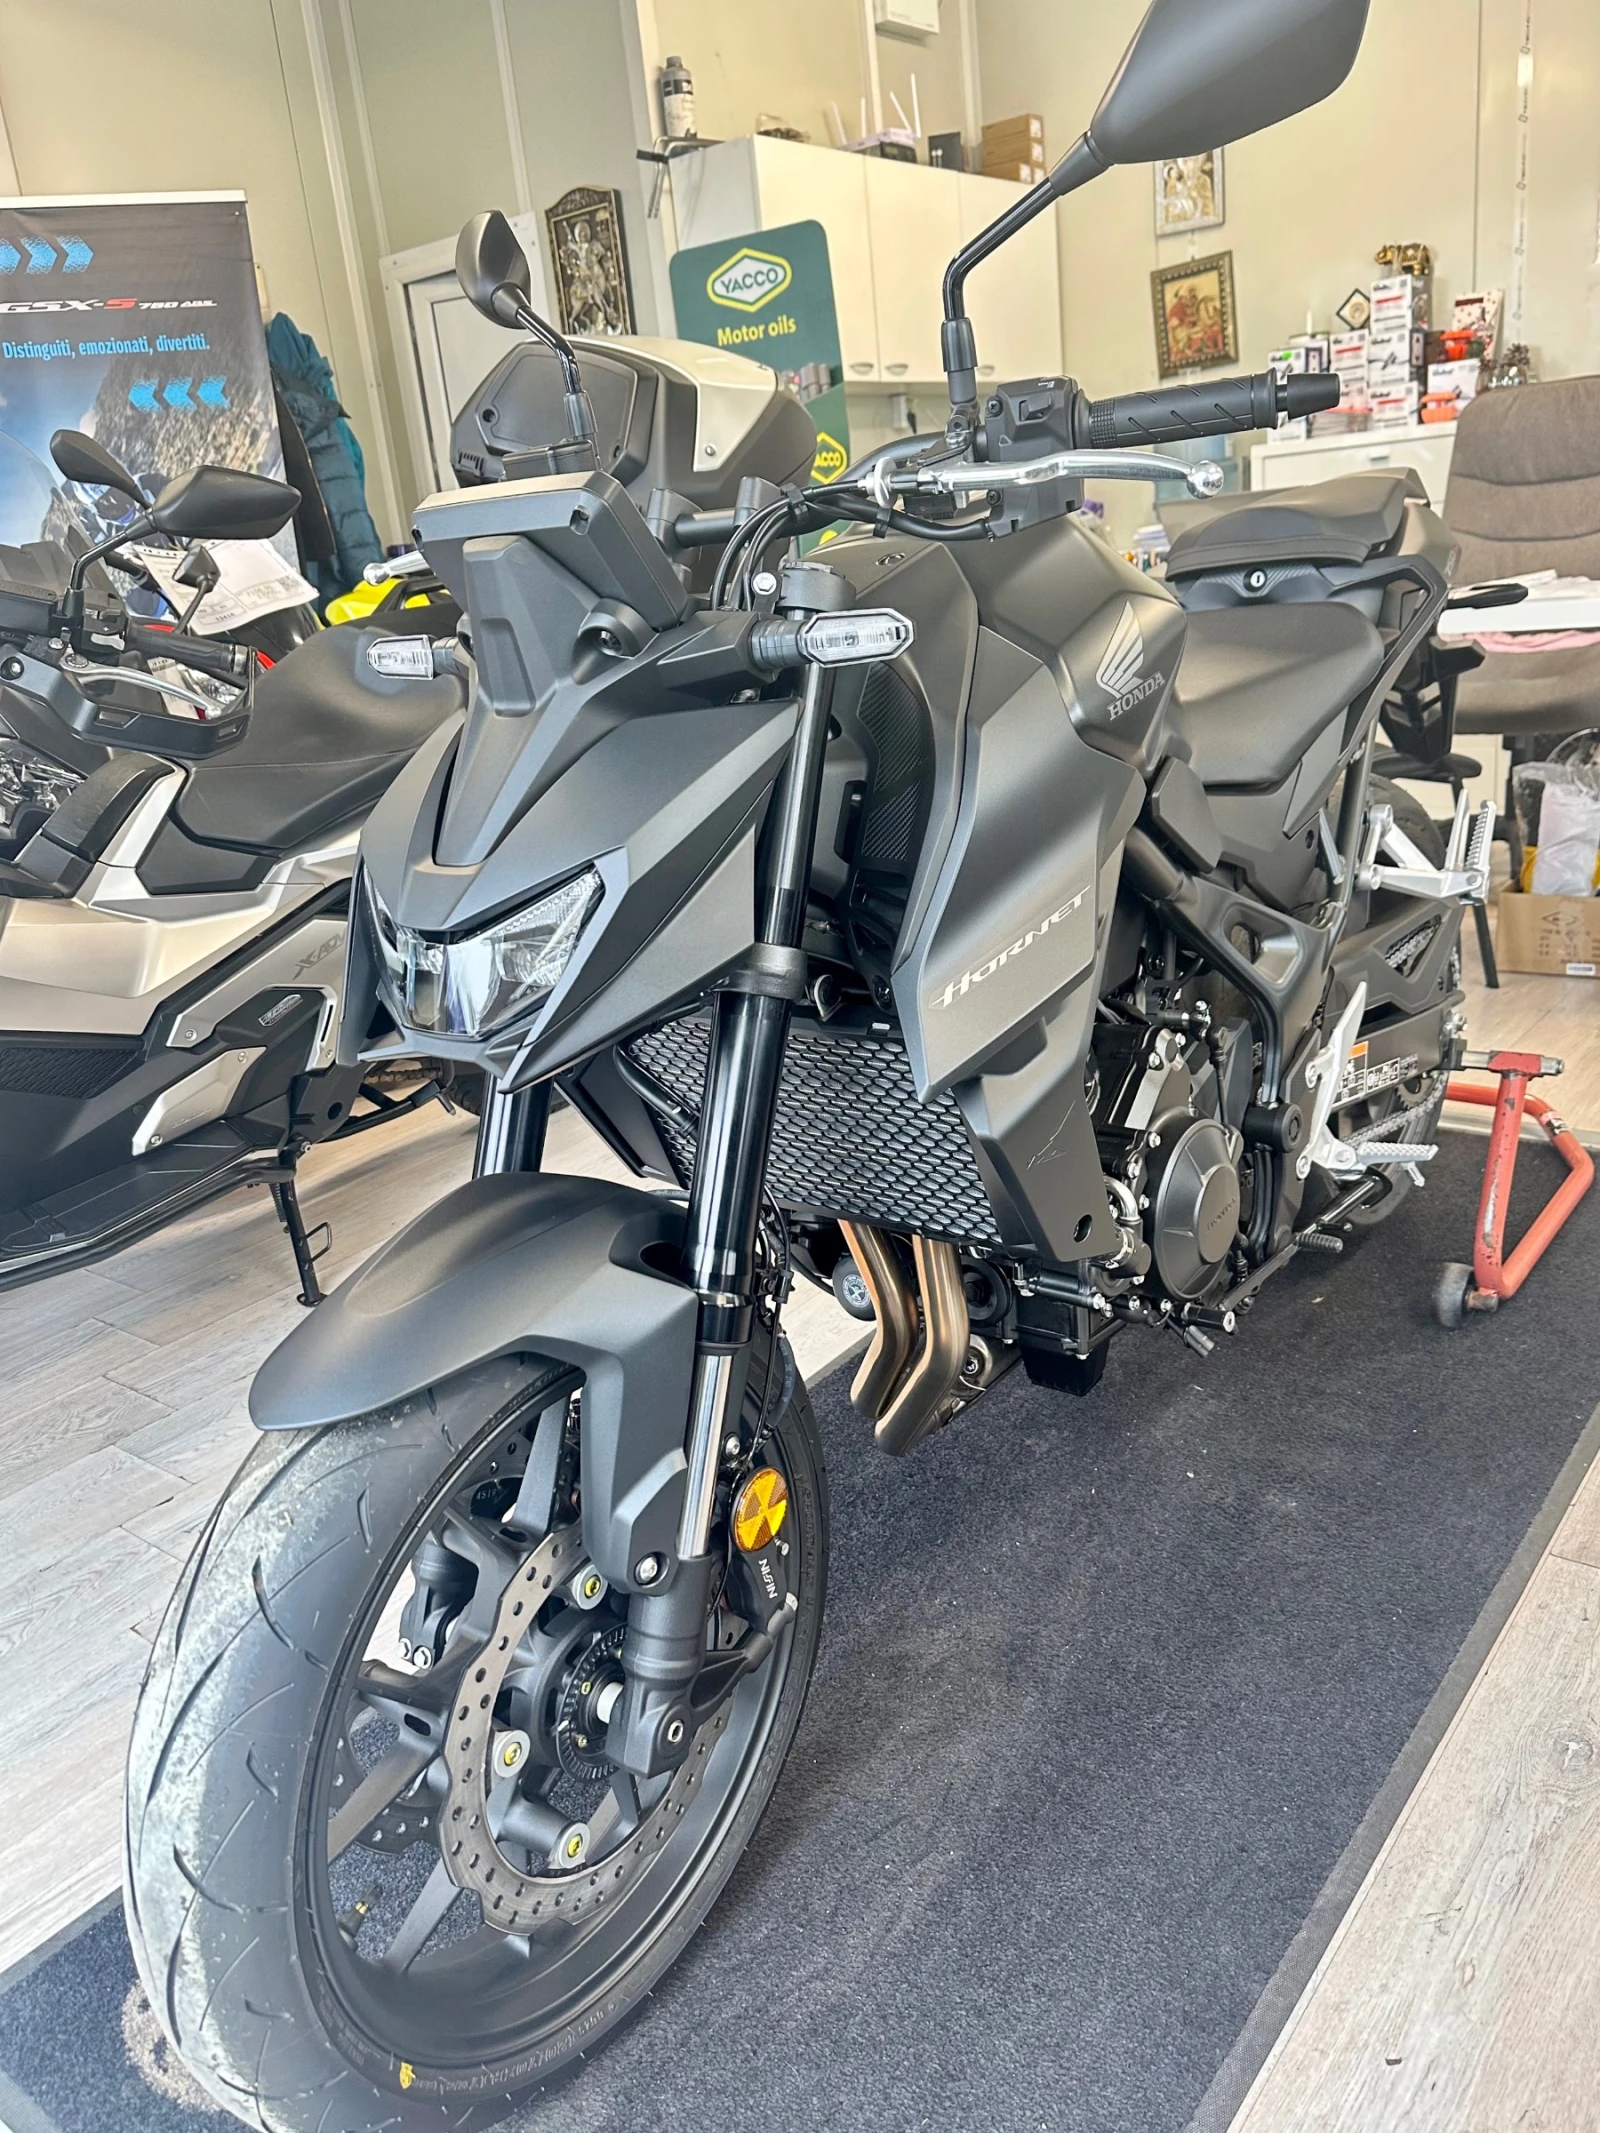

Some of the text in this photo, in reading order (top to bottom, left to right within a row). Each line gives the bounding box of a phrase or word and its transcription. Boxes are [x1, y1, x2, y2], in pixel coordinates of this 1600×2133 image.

[720, 267, 779, 294] YACCO
[2, 333, 211, 361] Distinguiti, emozionati, divertiti.
[717, 315, 797, 347] Motor oils
[813, 451, 841, 467] ACCO
[1107, 670, 1166, 721] HONDA
[930, 884, 1091, 1008] HORNET
[758, 1558, 778, 1599] NISSIN
